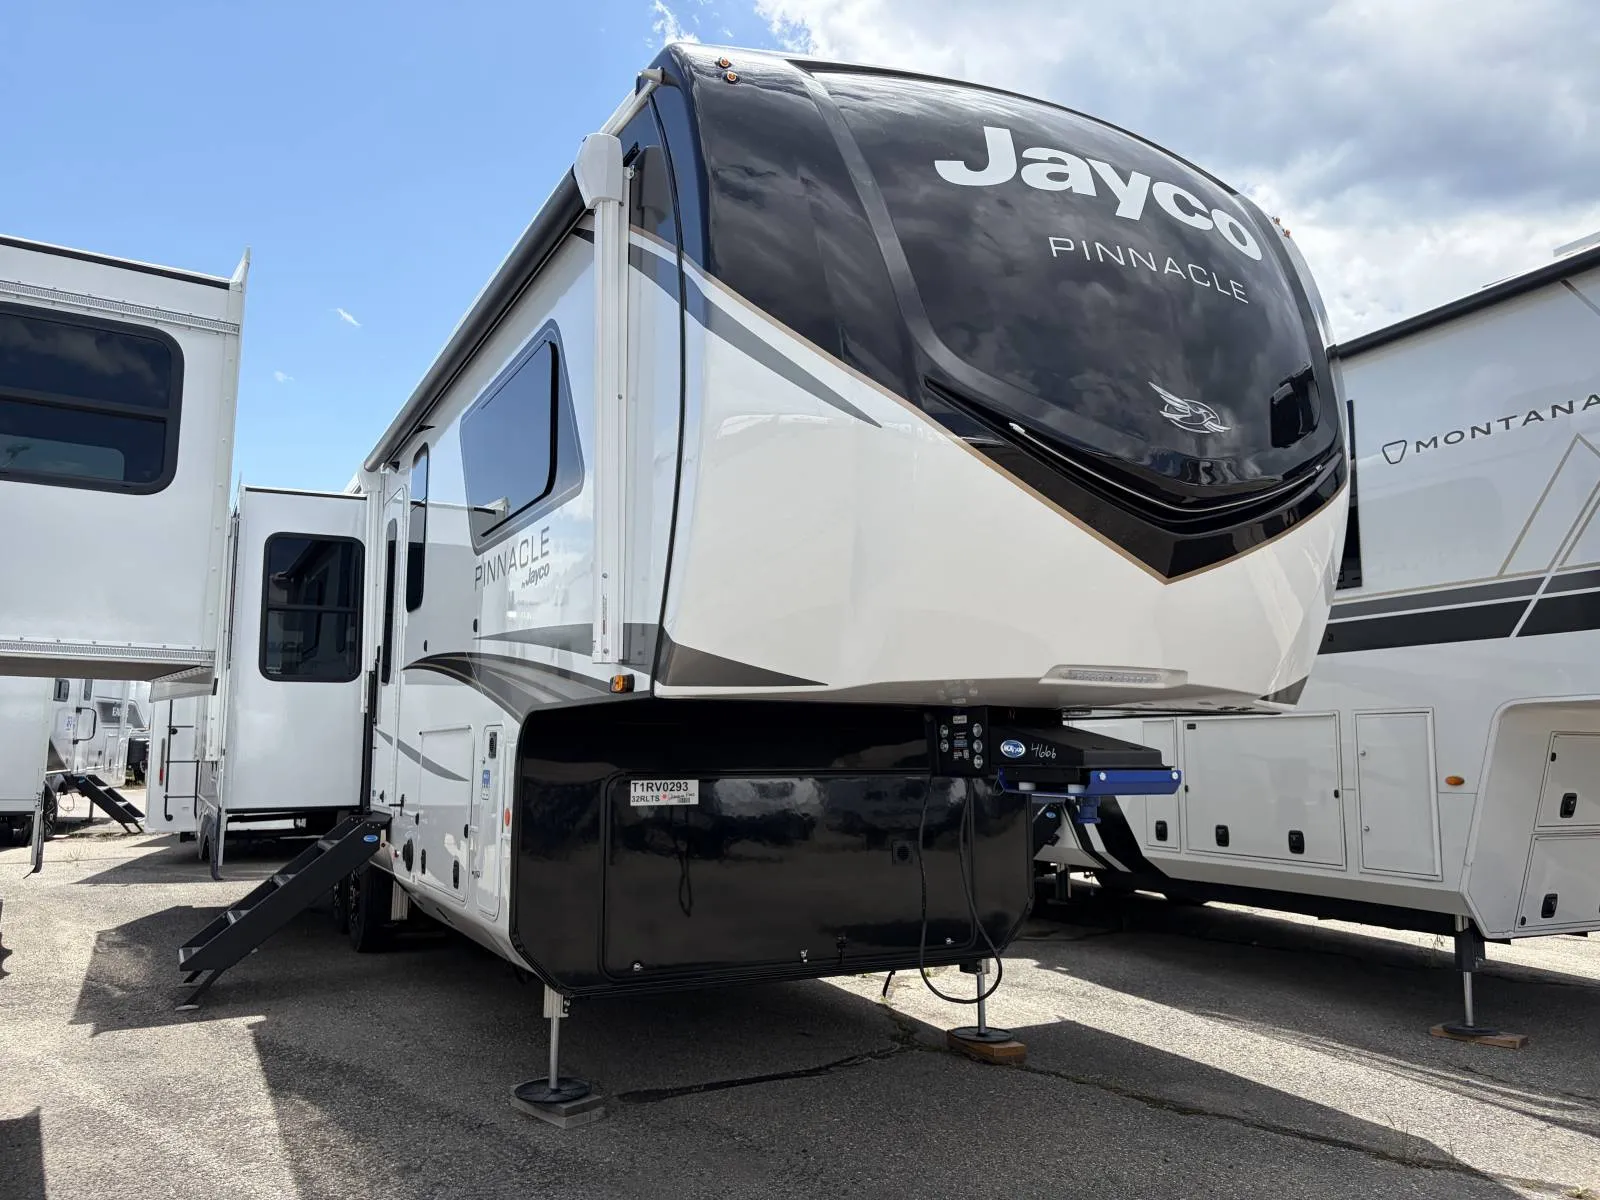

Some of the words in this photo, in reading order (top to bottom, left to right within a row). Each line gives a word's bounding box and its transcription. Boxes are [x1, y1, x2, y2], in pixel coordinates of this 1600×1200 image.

[934, 126, 1262, 261] Jayco
[1049, 236, 1249, 304] PINNACLE
[1415, 394, 1600, 453] MONTANA
[474, 526, 550, 592] PINNACLE
[631, 781, 689, 792] T1RV0293
